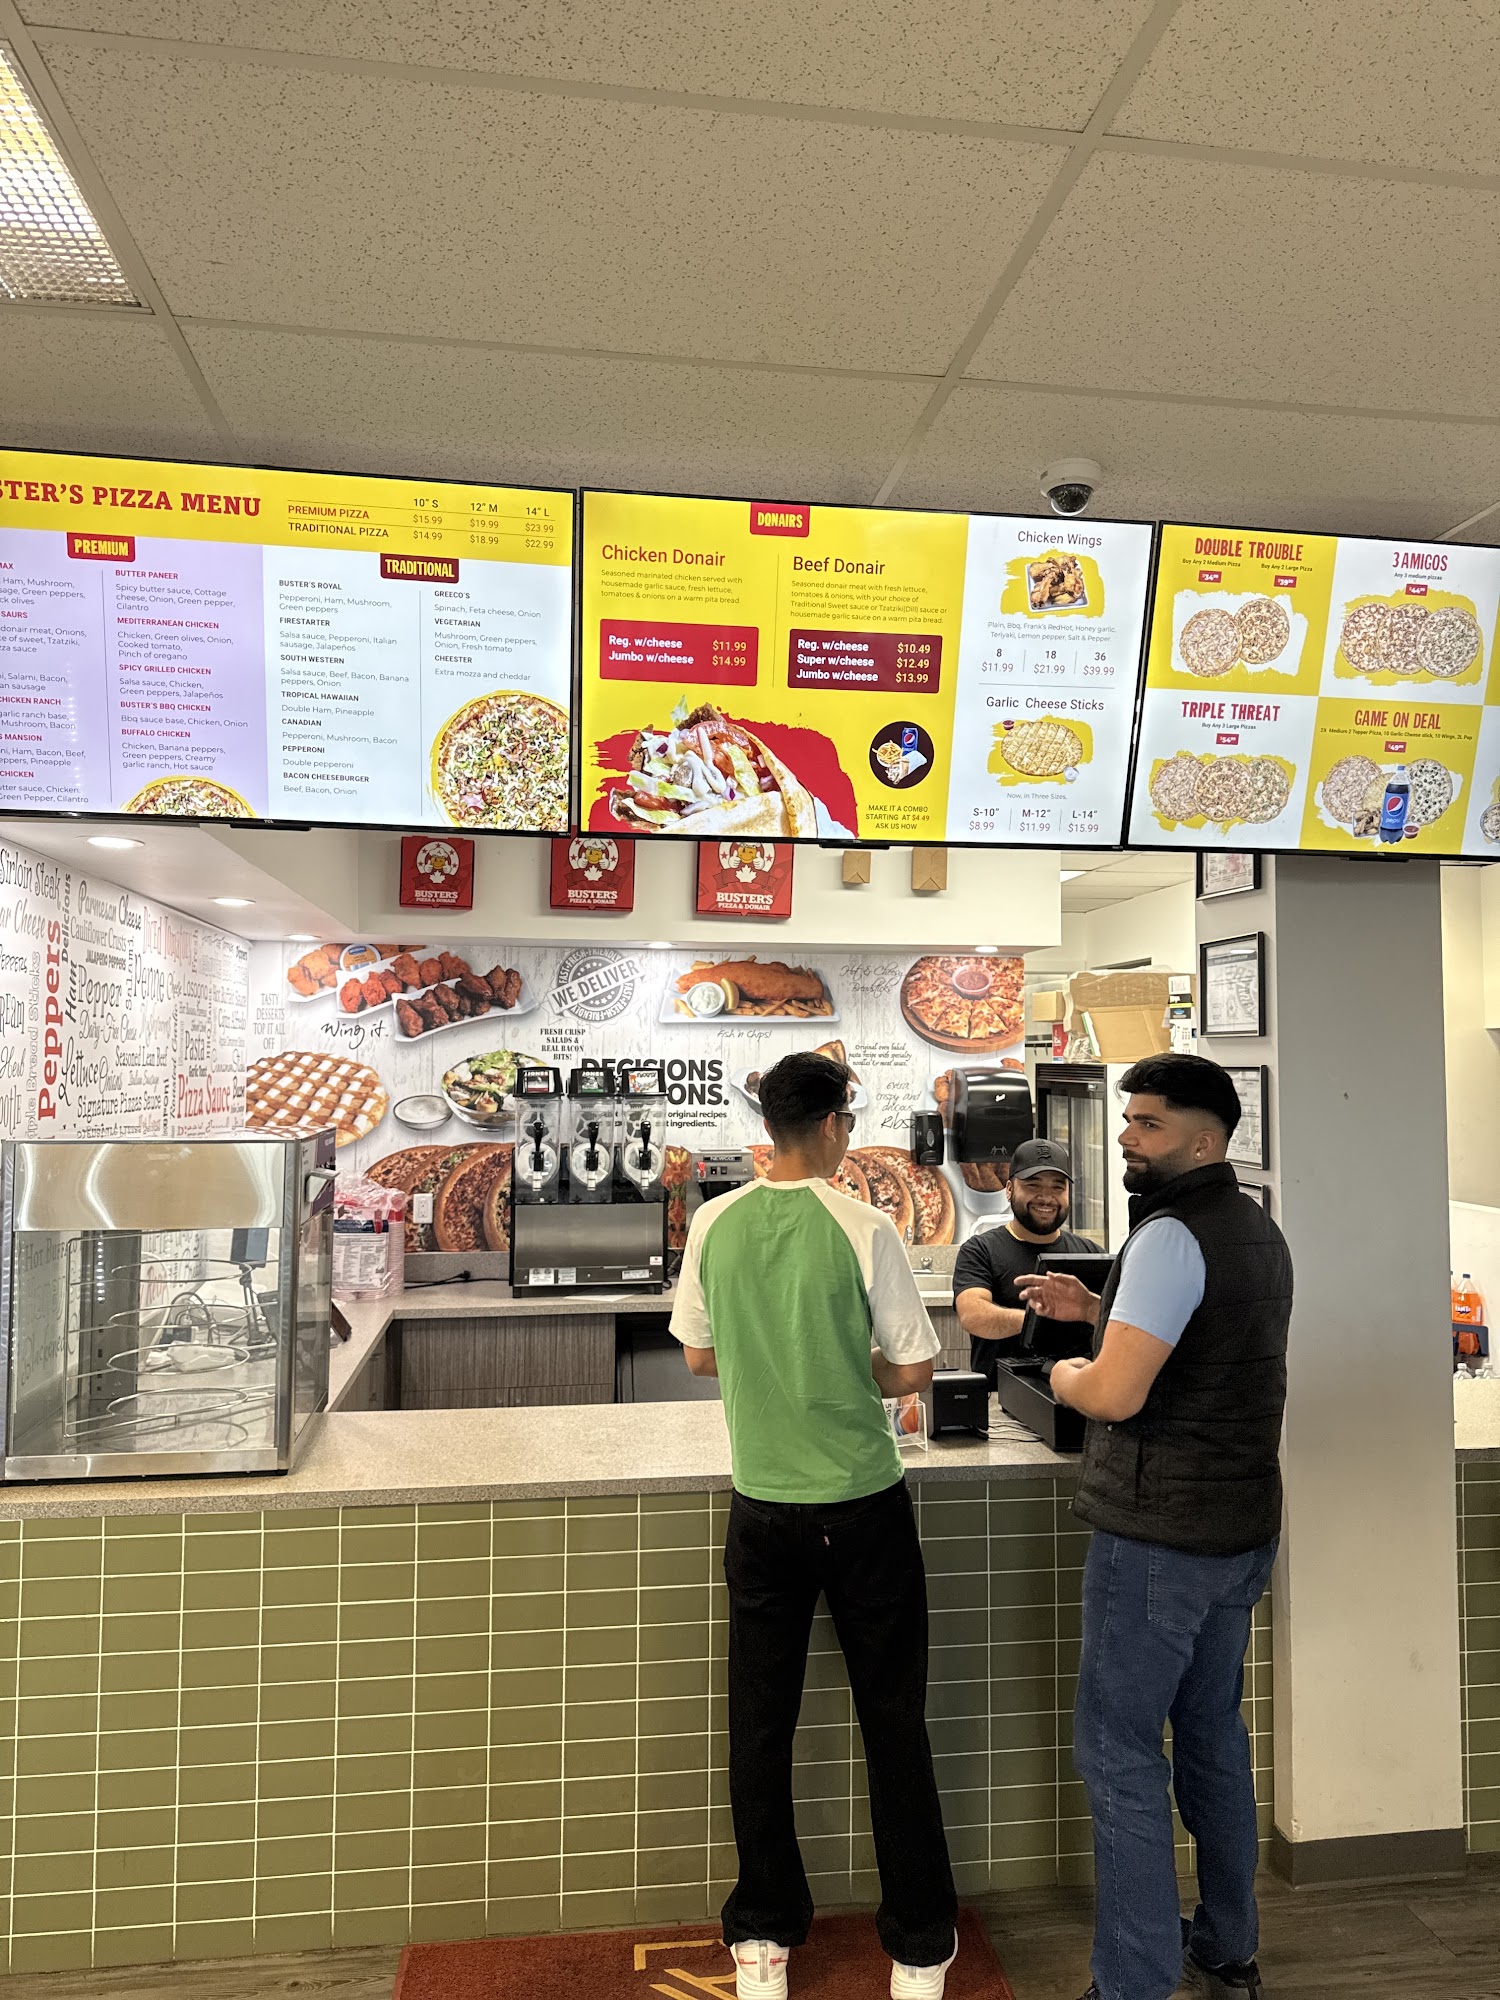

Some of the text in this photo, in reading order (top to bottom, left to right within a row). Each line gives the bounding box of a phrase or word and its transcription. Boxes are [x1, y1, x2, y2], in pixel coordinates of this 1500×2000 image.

[92, 486, 173, 510] PIZZA
[180, 492, 261, 516] MENU
[431, 499, 439, 508] S
[287, 505, 370, 519] PREMIUM PIZZA
[488, 503, 498, 512] M
[543, 508, 549, 516] L
[412, 513, 443, 524] $15.99
[469, 518, 499, 528] $19.99
[757, 512, 803, 528] DONAIRS
[287, 522, 389, 537] TRADITIONAL PIZZA
[525, 522, 554, 533] $23.99
[412, 530, 443, 540] $14.99
[469, 534, 499, 544] $18.99
[1017, 530, 1102, 548] Chicken Wings
[73, 539, 128, 556] PREMIUM
[525, 538, 554, 548] $22.99
[1194, 537, 1304, 561] DOUBLE TROUBLE
[601, 544, 726, 566] Chicken Donair
[793, 556, 886, 574] Beef Donair
[1392, 551, 1448, 571] 3 AMIGOS
[384, 559, 455, 577] TRADITIONAL
[278, 579, 316, 588] BUSTER'S
[115, 583, 227, 598] Spicy butter sauce, Cottage
[434, 590, 470, 598] GREECO'S
[116, 617, 219, 628] MEDITERRANEAN CHICKEN
[279, 617, 330, 626] FIRESTARTER
[434, 618, 481, 627] VEGETARIAN
[607, 635, 683, 648] Reg. w/cheese
[711, 639, 747, 651] $11.99
[797, 639, 869, 651] Reg. w/cheese
[897, 642, 932, 653] $10.49
[996, 648, 1003, 657] 8
[434, 654, 472, 663] CHEESTER
[608, 650, 694, 664] Jumbo w/cheese
[712, 654, 746, 666] $14.99
[796, 653, 875, 666] Super w/cheese
[1045, 650, 1057, 659] 18
[1094, 651, 1107, 661] 36
[896, 657, 930, 668] $12.49
[981, 661, 1014, 672] $11.99
[1033, 663, 1066, 674] $21.99
[1082, 665, 1115, 675] $39.99
[795, 668, 880, 681] Jumbo w/cheese
[895, 671, 929, 683] $13.99
[280, 690, 359, 701] TROPICAL HAWAIIAN
[986, 696, 1104, 710] Garlic Cheese Sticks
[1181, 701, 1281, 721] TRIPLE THREAT
[281, 718, 322, 726] CANADIAN
[1354, 709, 1441, 729] GAME ON DEAL
[282, 745, 325, 753] PEPPERONI
[311, 773, 369, 782] CHEESEBURGER
[968, 820, 995, 830] $8.99
[1019, 821, 1051, 831] $11.99
[1067, 822, 1099, 832] $15.99
[34, 862, 60, 910] Steak
[414, 890, 458, 899] BUSTER'S
[568, 890, 618, 899] BUSTER'S
[716, 892, 773, 904] BUSTER'S
[62, 873, 71, 963] Delicious
[552, 960, 640, 1007] WE DELIVER
[78, 964, 122, 1018] Pepper
[26, 950, 40, 1092] Bread Sticks
[38, 920, 63, 1121] Peppers
[320, 1020, 388, 1050] Wing it.
[184, 1030, 204, 1060] Pasta
[177, 1074, 230, 1118] Pizza Sauce
[668, 1110, 727, 1120] original recipes
[670, 1120, 717, 1129] ingredients.
